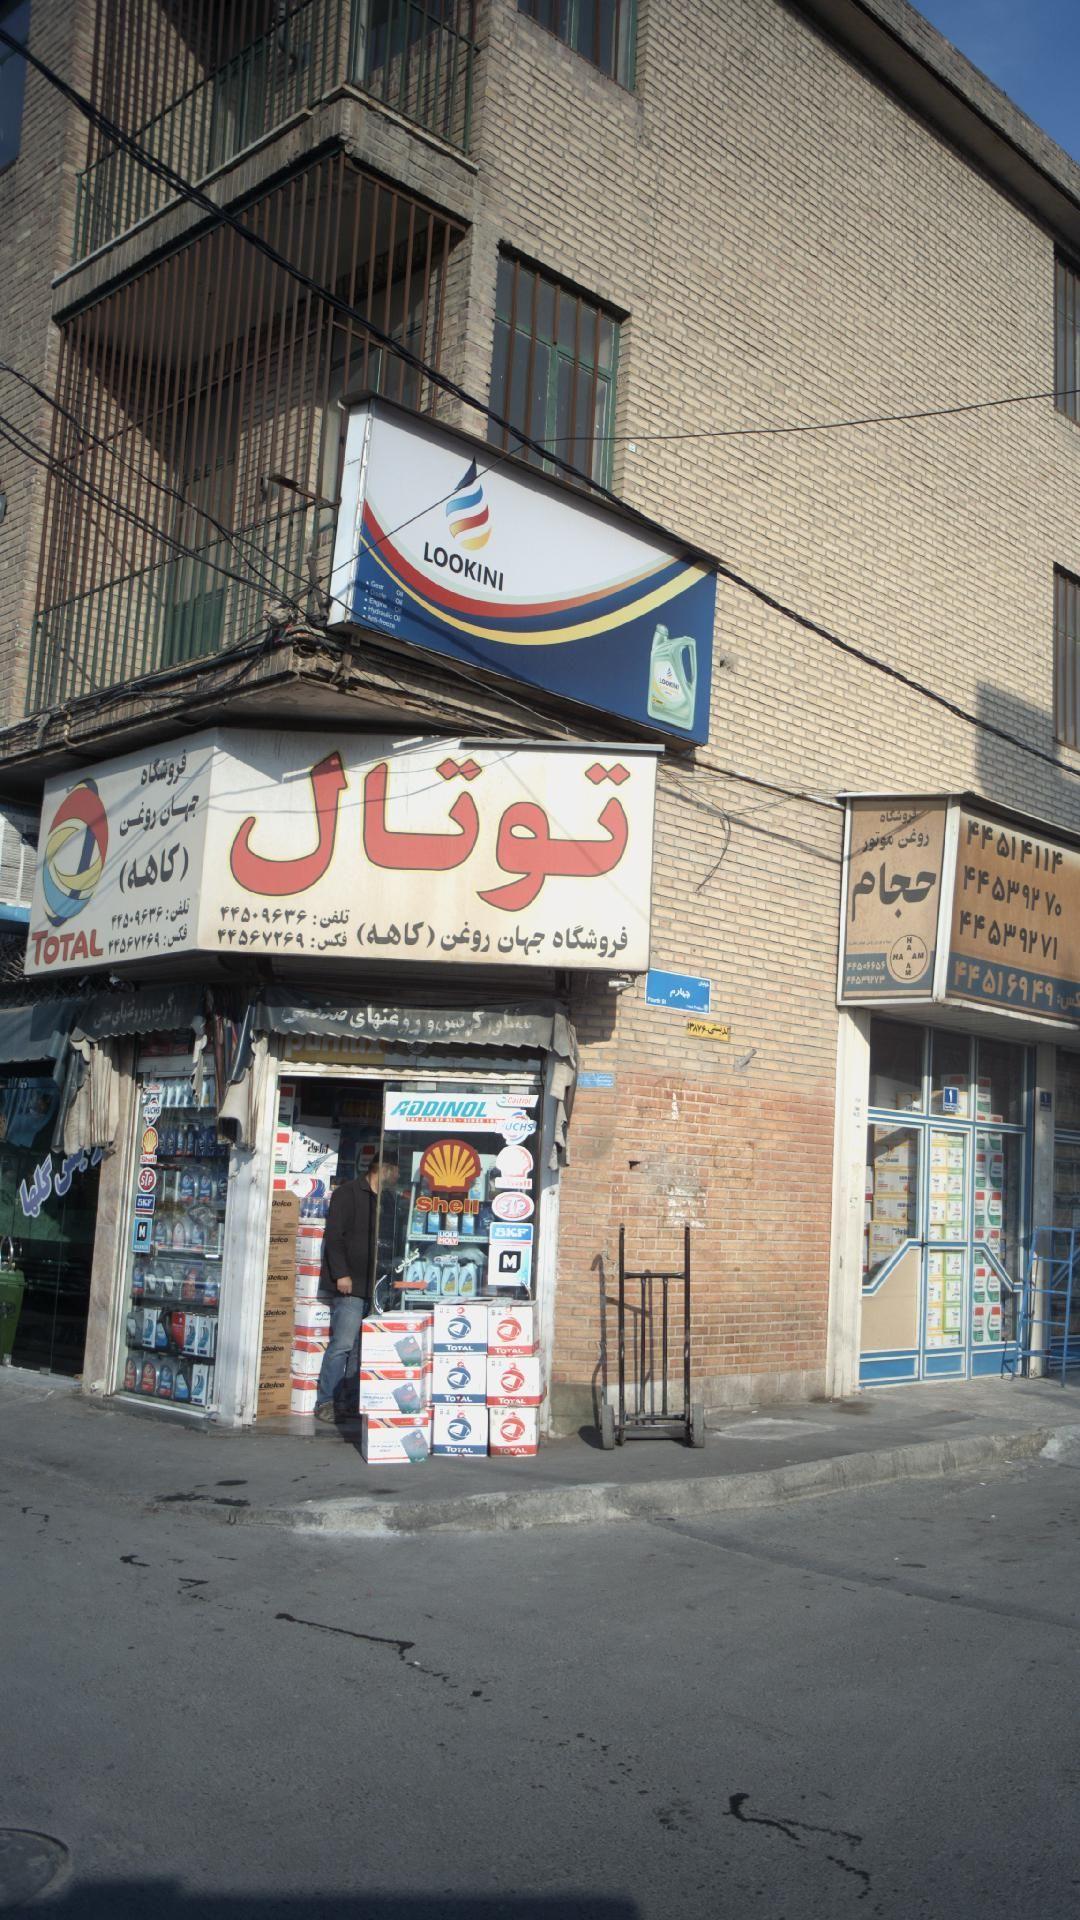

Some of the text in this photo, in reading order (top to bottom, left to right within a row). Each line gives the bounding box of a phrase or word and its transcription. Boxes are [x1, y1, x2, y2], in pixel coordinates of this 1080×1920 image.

[423, 541, 505, 592] LOOKINI
[140, 748, 187, 786] فروشگاه
[119, 794, 200, 837] جهان روغن
[229, 751, 630, 912] توتال
[898, 828, 930, 849] روغن
[967, 820, 1064, 874] ۴۴۵۱۴۱۱۴
[851, 861, 937, 922] حجام
[963, 865, 1062, 917] ۴۴۵۳۹۲۷۰
[111, 906, 163, 931] ۴۴۵۰۹۶۳۶
[220, 905, 308, 925] ۴۴۵۰۹۶۳۶
[31, 928, 104, 967] TOTAL
[217, 928, 305, 949] ۴۴۵۶۷۲۶۹
[440, 921, 491, 953] روغن
[497, 925, 546, 956] جهان
[552, 926, 629, 958] فروشگاه
[959, 909, 1058, 961] ۴۴۵۳۹۲۷۱
[669, 986, 691, 999] چهارم
[954, 961, 1054, 1007] ۴۴۵۱۶۹۴۹
[389, 1100, 489, 1118] ADDINOL
[505, 1121, 535, 1132] UCHS
[140, 1172, 154, 1188] STP
[415, 1195, 480, 1215] Shell
[494, 1226, 529, 1238] SKF
[499, 1397, 526, 1405] TOTAL
